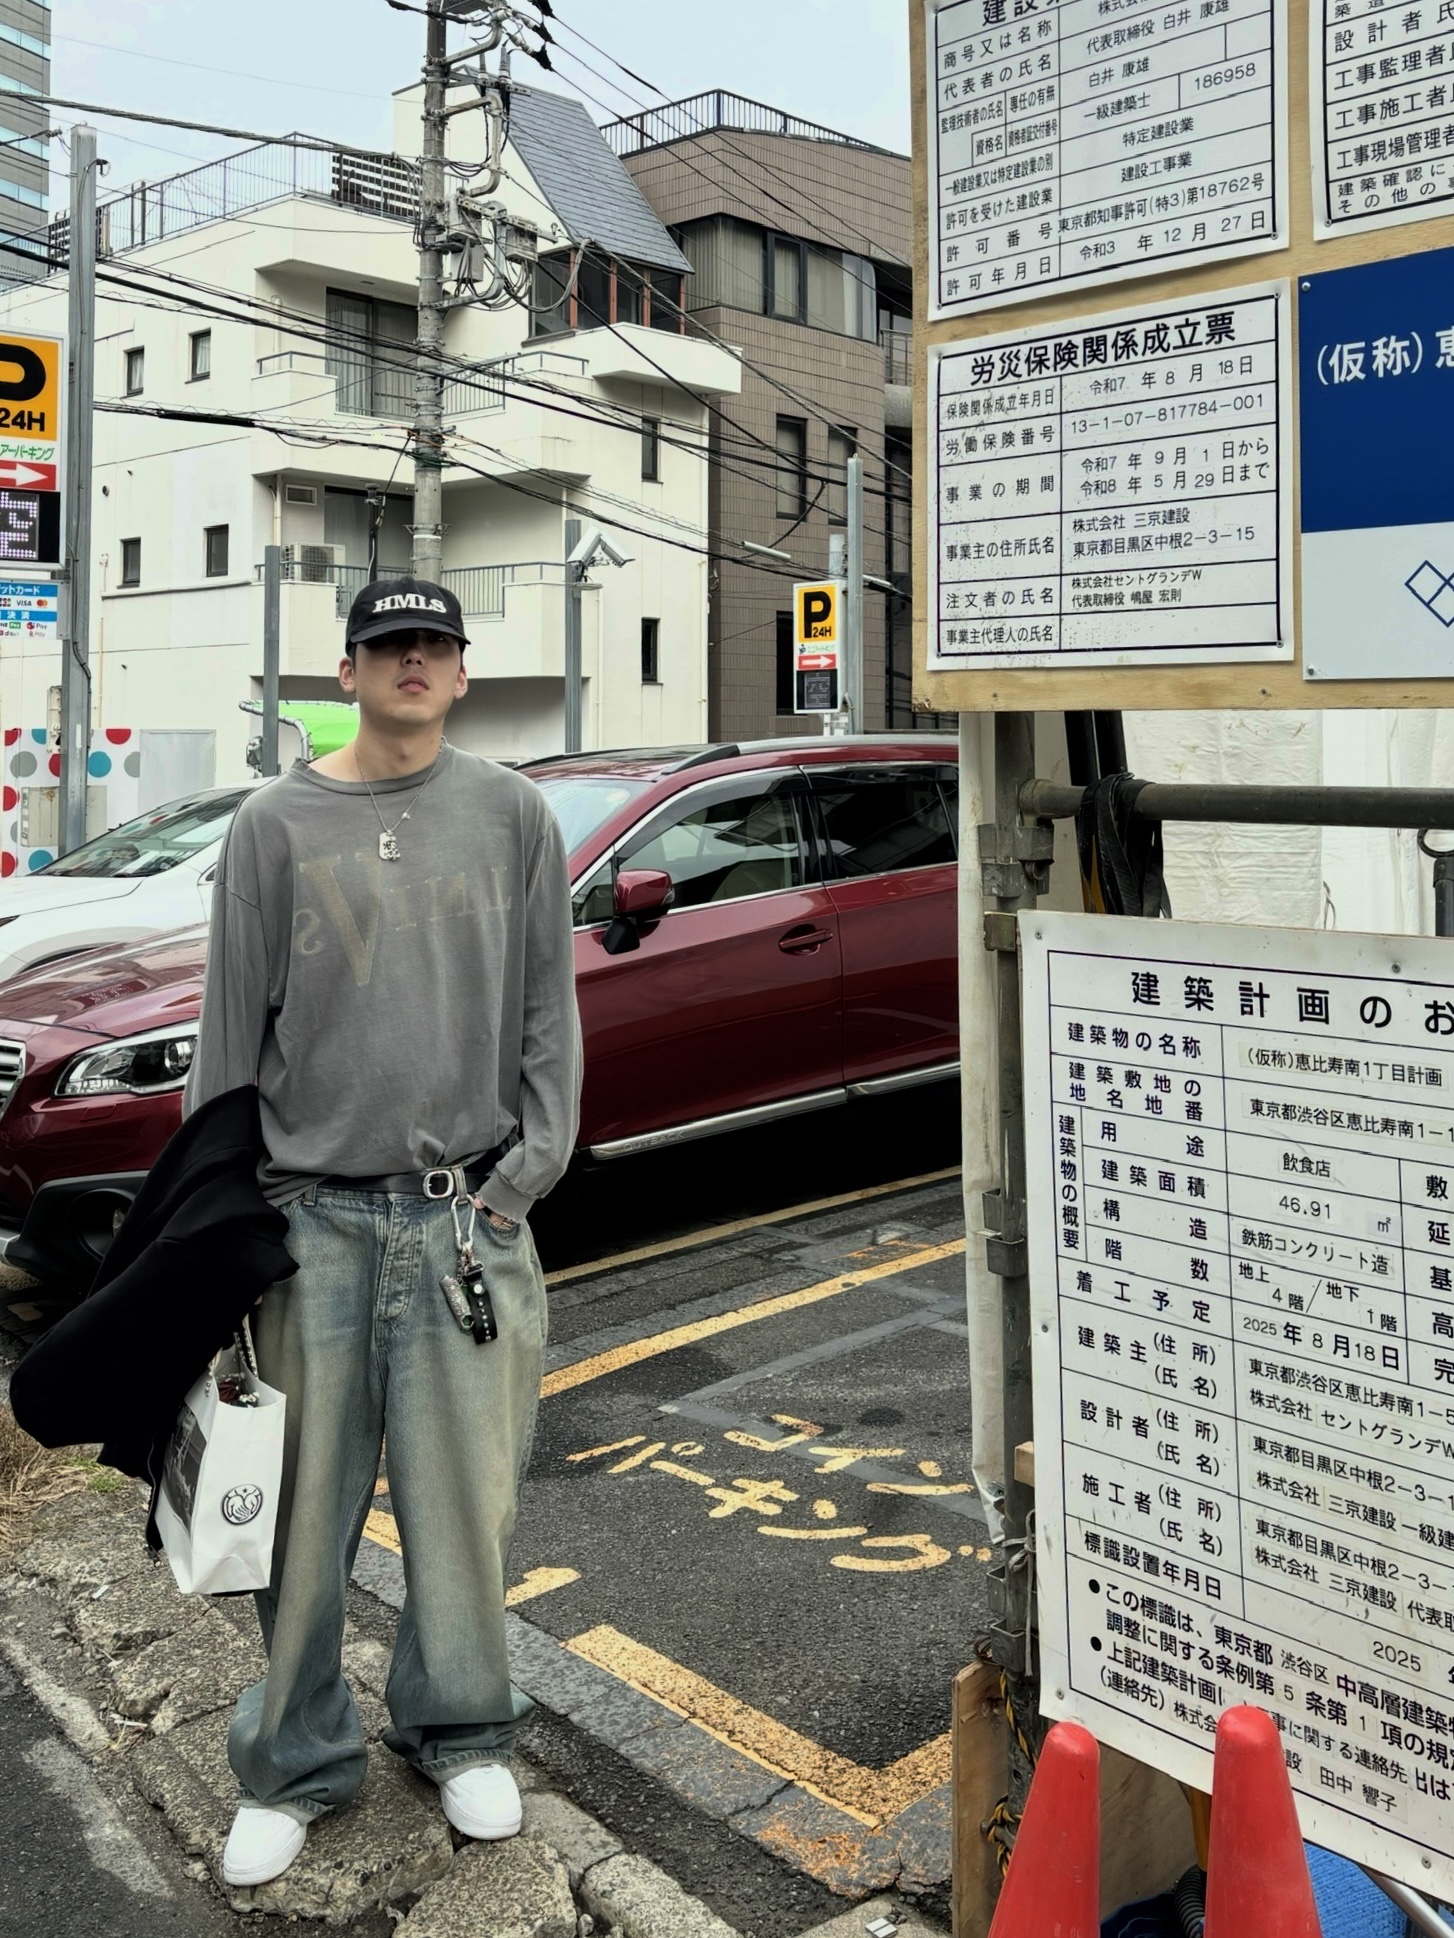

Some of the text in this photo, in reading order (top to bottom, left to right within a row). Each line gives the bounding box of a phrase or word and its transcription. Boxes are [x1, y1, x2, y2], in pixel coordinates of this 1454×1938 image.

[982, 0, 1061, 26] 建設
[944, 19, 1052, 70] 商号又は名称
[1087, 19, 1154, 55] 代表取締役
[1164, 8, 1191, 30] 白井
[944, 53, 1052, 100] 代表者の氏名
[1089, 57, 1149, 88] 白井 康雄
[1194, 63, 1256, 91] 186958
[1334, 42, 1454, 90] 工事監理者
[941, 100, 1003, 134] 監理技術者の氏名
[1009, 85, 1055, 113] 専任の有無
[1084, 92, 1151, 120] 一級建築士
[1335, 82, 1454, 130] 工事施工者
[976, 135, 1003, 157] 資格名
[1122, 117, 1194, 147] 特定建設業
[945, 152, 1053, 195] 一般建設業又は特定建設業の別
[1121, 151, 1192, 183] 建設工事業
[1338, 163, 1454, 197] 建築確認に
[946, 187, 1053, 230] 許可を受けた建設業
[946, 222, 1053, 263] 許可番号
[947, 256, 1051, 296] 許可年月日
[970, 311, 1236, 386] 労災保険関係成立票
[0, 407, 46, 432] 24H
[946, 388, 1054, 420] 保険関係成立年月日
[946, 425, 1055, 456] 労働保険番号
[946, 475, 1054, 504] 事業の期間
[1072, 508, 1190, 533] 株式会社 三京建設
[946, 536, 1054, 561] 事業主の住所氏名
[1072, 569, 1202, 589] 株式会社セントグランデW
[372, 593, 447, 613] HMLS
[804, 591, 832, 639] P
[946, 587, 1053, 609] 注文者の氏名
[1072, 591, 1125, 608] 代表取締役
[812, 625, 832, 638] 24H
[946, 625, 1053, 645] 事業主代理人の氏名
[1068, 1022, 1201, 1059] 建築物の名称
[1069, 1062, 1201, 1096] 建築敷地の
[1248, 1048, 1442, 1087] (仮称)恵比寿南1丁目計画
[1070, 1083, 1203, 1121] 地名地番
[1058, 1114, 1079, 1250] 建築物の概要
[1101, 1159, 1206, 1199] 建築面積
[1283, 1152, 1330, 1177] 飲食店
[1279, 1195, 1331, 1219] 46.91
[1242, 1228, 1389, 1275] 鉄筋コンクリート造
[1077, 1270, 1211, 1323] 着工予定
[1239, 1262, 1270, 1283] 地上
[1326, 1281, 1359, 1302] 地下
[1078, 1326, 1147, 1363] 建築主
[1080, 1399, 1149, 1439] 設計者
[1250, 1388, 1313, 1422] 株式会社
[1082, 1473, 1151, 1515] 施工者
[1256, 1470, 1320, 1507] 株式会社
[1329, 1494, 1397, 1532] 三京建設
[1084, 1530, 1222, 1600] 標識設置年月日
[1255, 1518, 1454, 1590] 東京都目黒区中根2-3-
[1255, 1545, 1320, 1584] 株式会社
[1329, 1572, 1397, 1612] 三京建設
[1280, 1650, 1330, 1685] 渋谷区
[1100, 1666, 1165, 1711] (連絡先)
[1284, 1684, 1294, 1701] 5
[1380, 1720, 1454, 1771] 項の規
[1320, 1766, 1353, 1793] 田中
